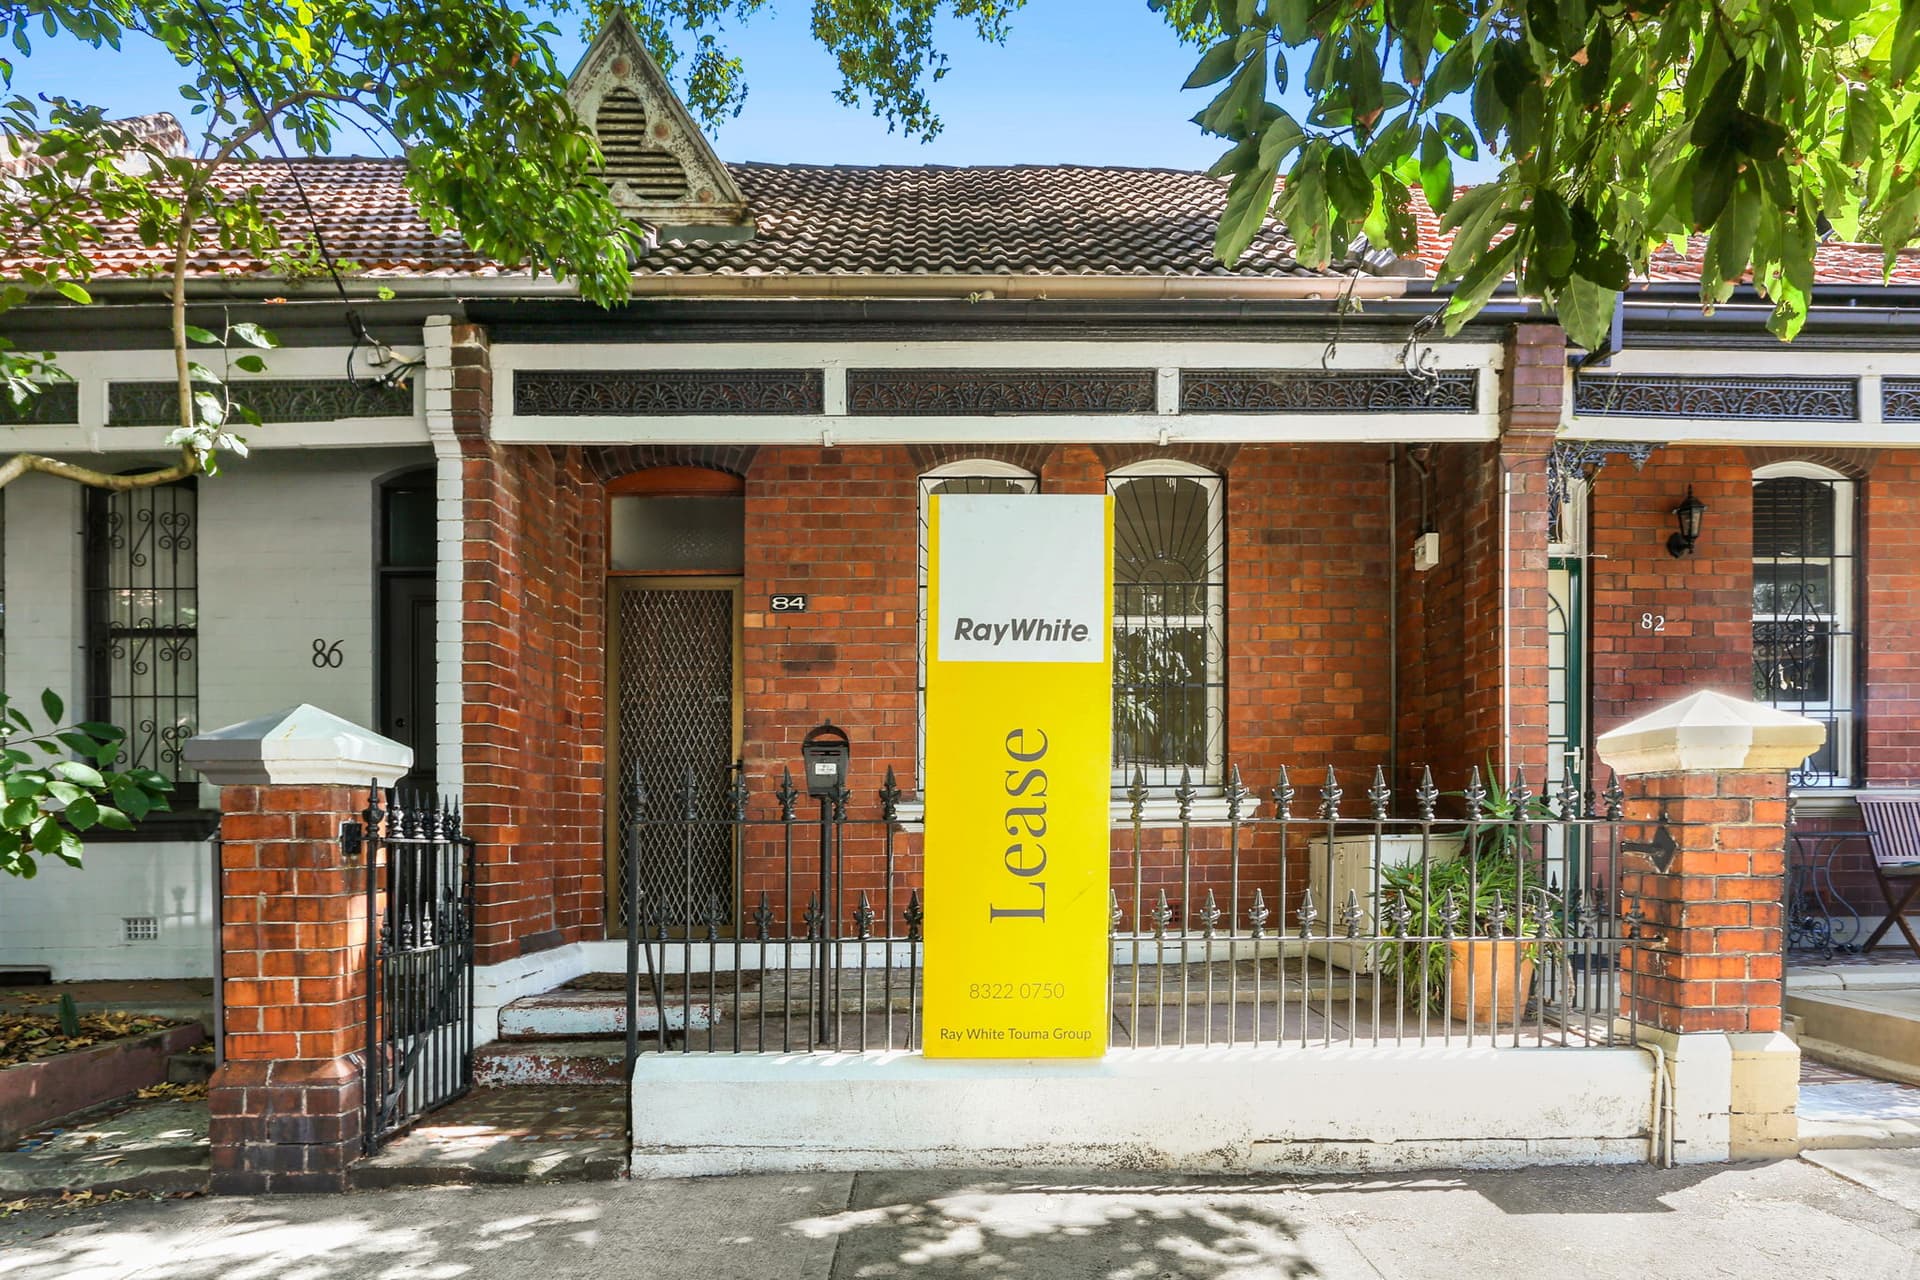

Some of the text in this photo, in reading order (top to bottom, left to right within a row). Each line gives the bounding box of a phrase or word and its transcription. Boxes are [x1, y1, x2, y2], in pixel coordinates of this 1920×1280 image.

[772, 596, 805, 610] 84
[1641, 612, 1665, 632] 82
[312, 638, 344, 668] 86
[990, 728, 1049, 924] Lease
[969, 983, 1065, 999] 8322 0750
[940, 1028, 1092, 1041] Ray White Touma Group
